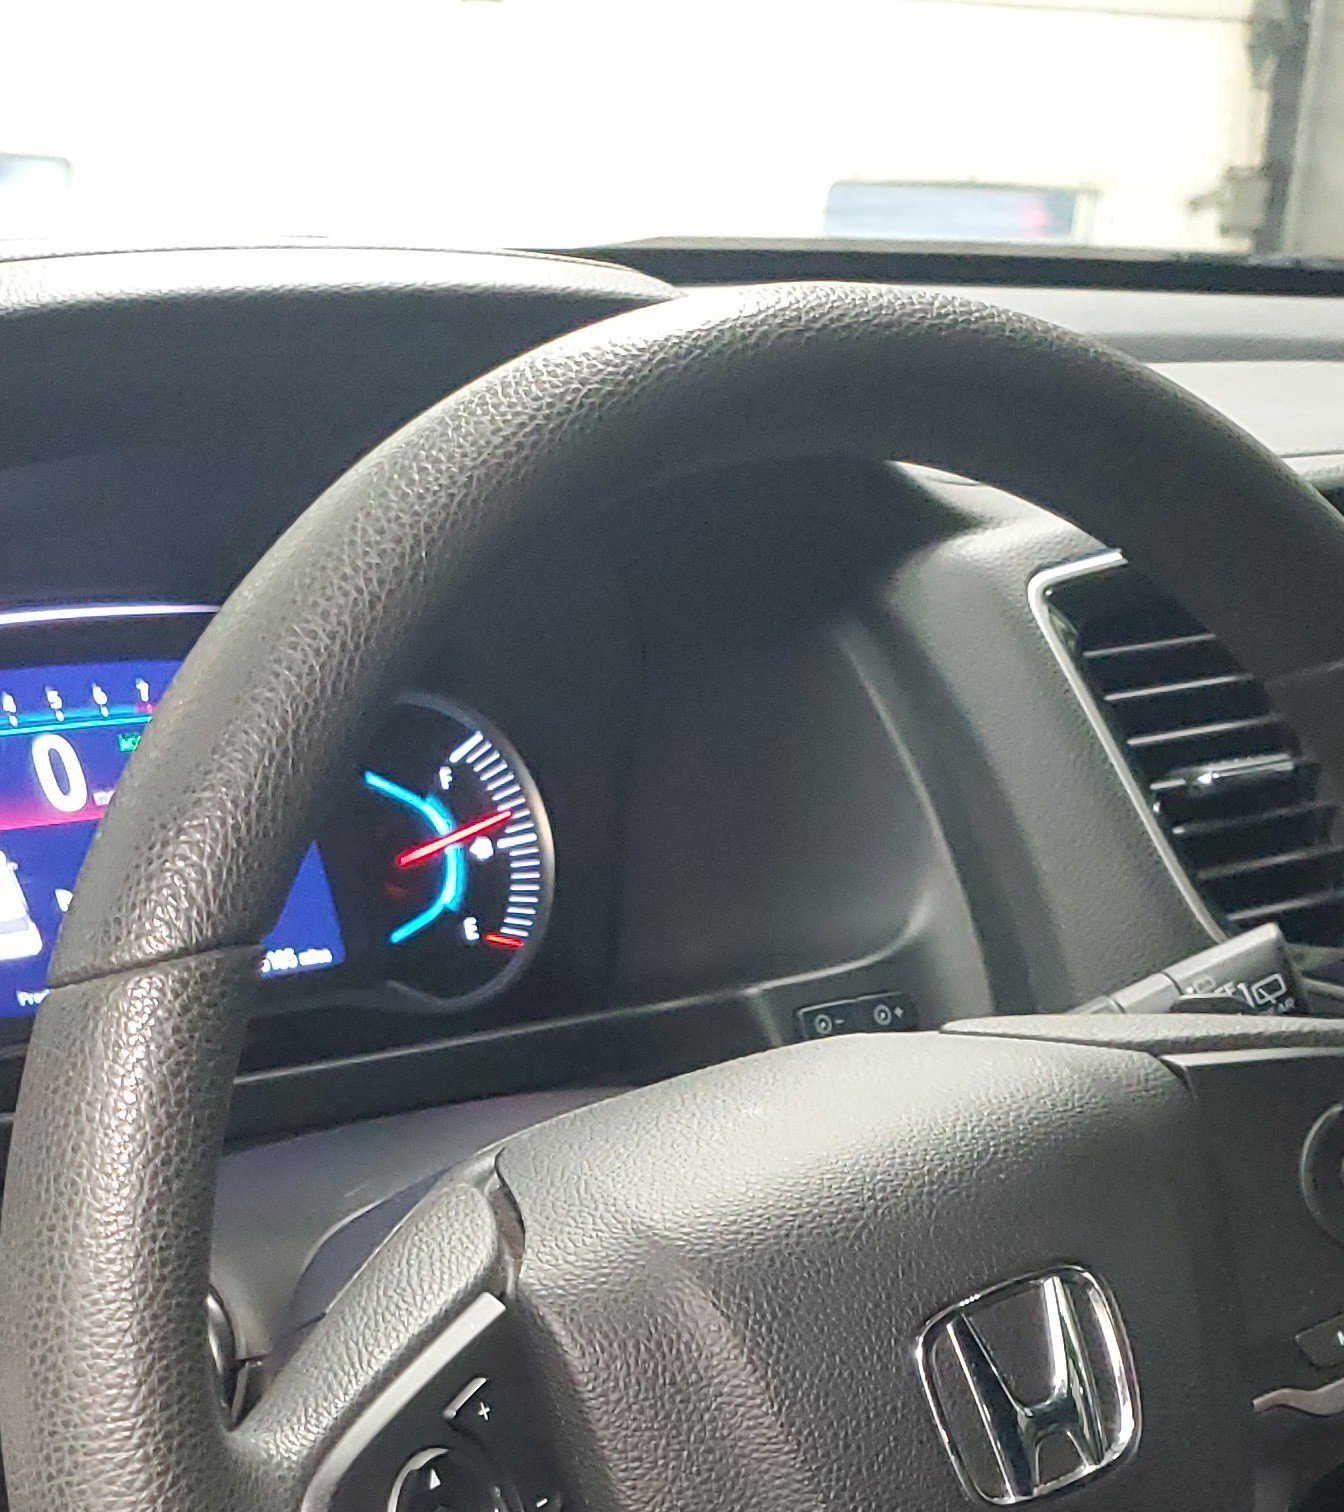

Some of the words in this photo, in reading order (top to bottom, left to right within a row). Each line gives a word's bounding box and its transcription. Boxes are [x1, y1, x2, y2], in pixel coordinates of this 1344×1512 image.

[32, 734, 89, 812] 0
[438, 765, 453, 790] F
[463, 916, 480, 943] E
